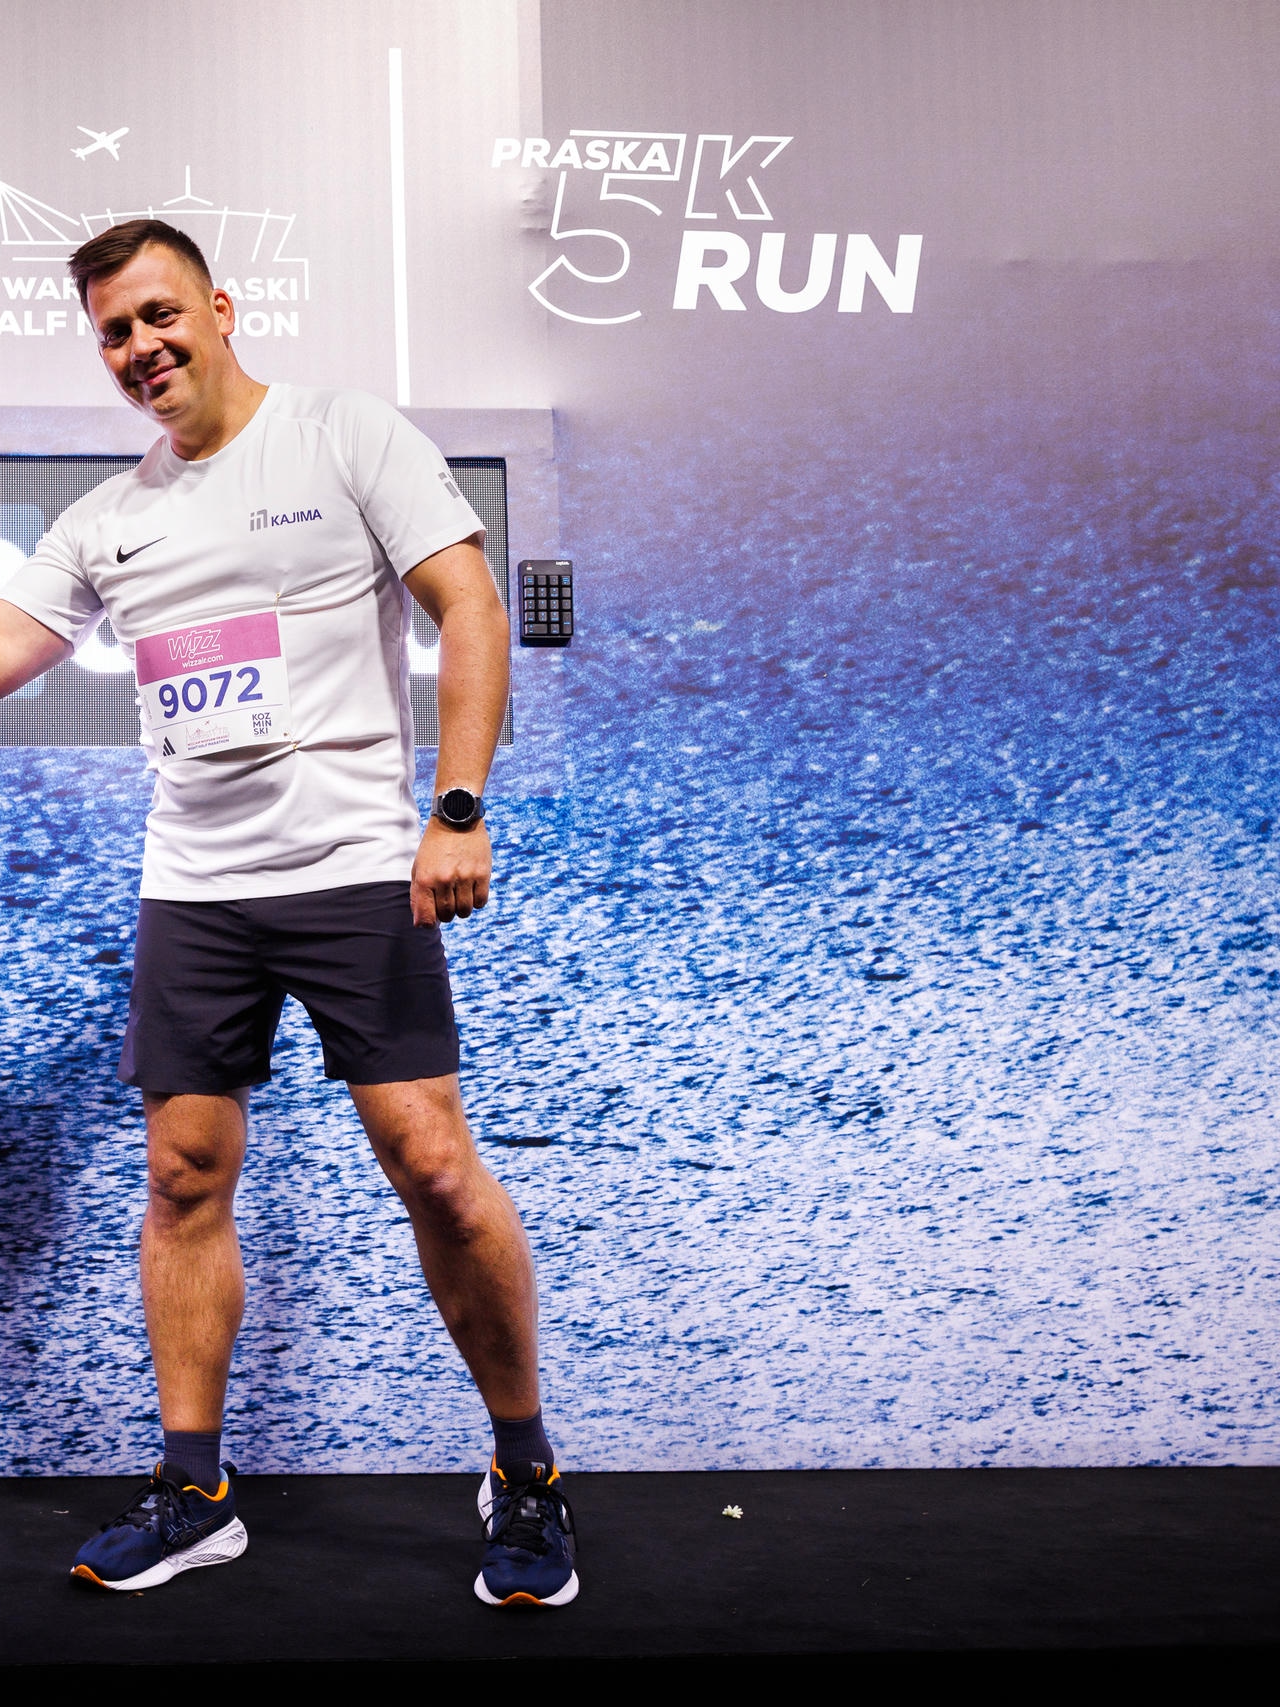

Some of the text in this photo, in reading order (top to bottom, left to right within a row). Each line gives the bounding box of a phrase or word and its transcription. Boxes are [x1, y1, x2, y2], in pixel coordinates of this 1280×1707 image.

[491, 137, 671, 172] PRASKA
[672, 230, 923, 314] RUN
[2, 276, 81, 300] WAR
[214, 277, 298, 301] ASKI
[271, 509, 322, 526] KAJIMA
[182, 654, 224, 668] wizzair.com
[158, 666, 263, 719] 9072
[252, 712, 271, 720] KOZ
[253, 720, 272, 728] MIN
[253, 728, 269, 736] SKI
